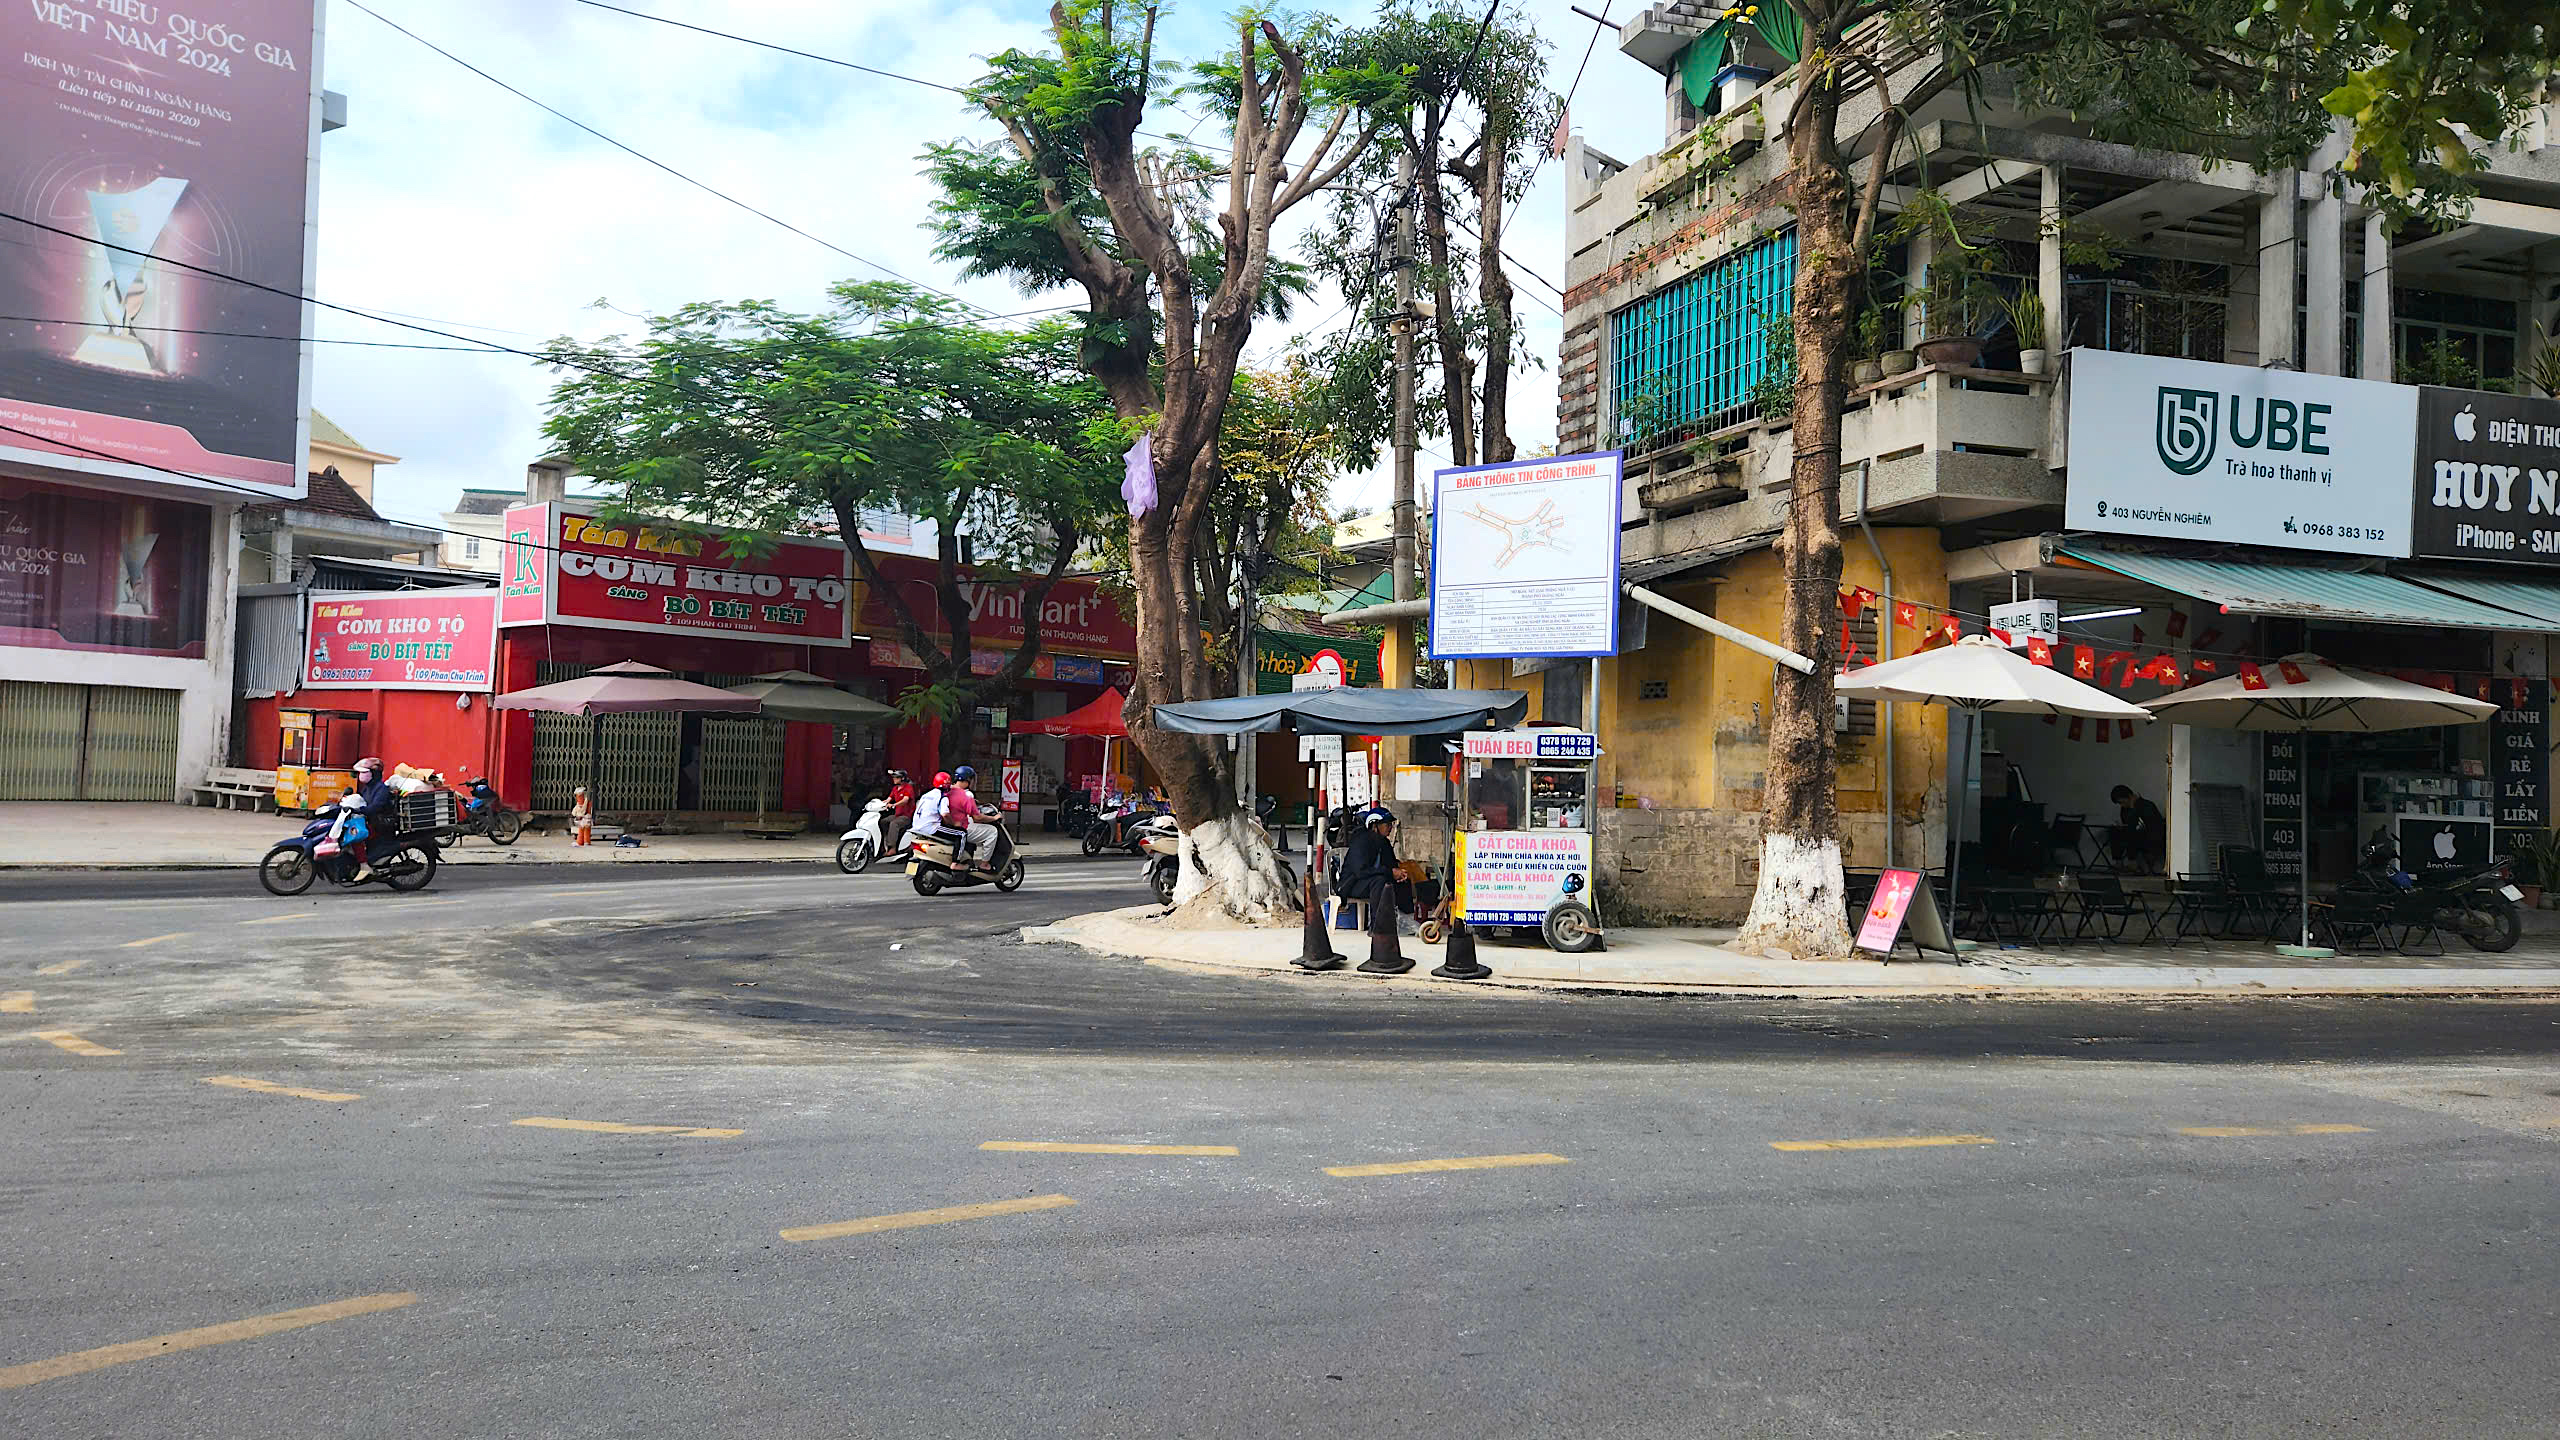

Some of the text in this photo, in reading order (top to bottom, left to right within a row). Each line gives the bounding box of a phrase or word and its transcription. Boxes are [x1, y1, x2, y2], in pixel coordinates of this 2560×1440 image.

[31, 0, 232, 78] VIỆT NAM 2024
[168, 14, 246, 53] QUỐC
[254, 42, 297, 72] GIA
[58, 79, 88, 97] (Liên
[92, 88, 117, 105] tiếp
[168, 110, 201, 128] 2020)
[195, 102, 232, 122] HÀNG
[2230, 395, 2332, 455] UBE
[2489, 418, 2530, 447] ĐIỆN
[1456, 464, 1596, 489] BẢNG THÔNG TIN CÔNG TRÌNH
[2226, 459, 2332, 487] Trà hoa thanh vị
[2432, 460, 2560, 517] HUY N
[2112, 507, 2212, 525] 403 NGUYỄN NGHIÊM
[2303, 523, 2385, 540] 0968 383 152
[2456, 523, 2516, 550] iPhone
[16, 546, 58, 562] QUỐC
[62, 552, 87, 565] GIA
[21, 562, 51, 576] 2024
[523, 583, 541, 595] Kim
[560, 551, 846, 609] CƠM KHO TỘ
[607, 585, 648, 600] SÁNG
[664, 593, 807, 625] BÒ BÍT TẾT
[337, 613, 465, 637] CƠM KHO TỘ
[677, 618, 692, 626] 109
[2011, 614, 2032, 627] UBE
[369, 638, 391, 660] BÒ
[394, 638, 421, 660] BÍT
[424, 636, 453, 661] TẾT
[1267, 651, 1296, 675] hóa
[321, 667, 340, 680] 0962
[341, 667, 356, 680] 970
[357, 667, 373, 680] 977
[414, 668, 430, 681] 109
[430, 669, 449, 681] Phan
[449, 670, 464, 682] Chu
[1467, 736, 1502, 754] TUẤN
[1541, 737, 1591, 746] 0378 919 729
[2272, 739, 2293, 758] ĐỔI
[2506, 732, 2534, 748] GIÁ
[1561, 747, 1575, 755] 240
[1577, 747, 1591, 756] 435
[2510, 755, 2531, 772] RẺ
[2268, 766, 2296, 785] ĐIỆN
[2505, 779, 2536, 797] LẤY
[2264, 793, 2301, 809] THOẠI
[2503, 803, 2539, 821] LIỀN
[1478, 834, 1577, 851] CẮT CHÌA KHÓA
[2272, 830, 2295, 844] 403
[1491, 852, 1512, 860] TRÌNH
[1467, 872, 1491, 882] LÀM
[1495, 872, 1521, 882] CHÌA
